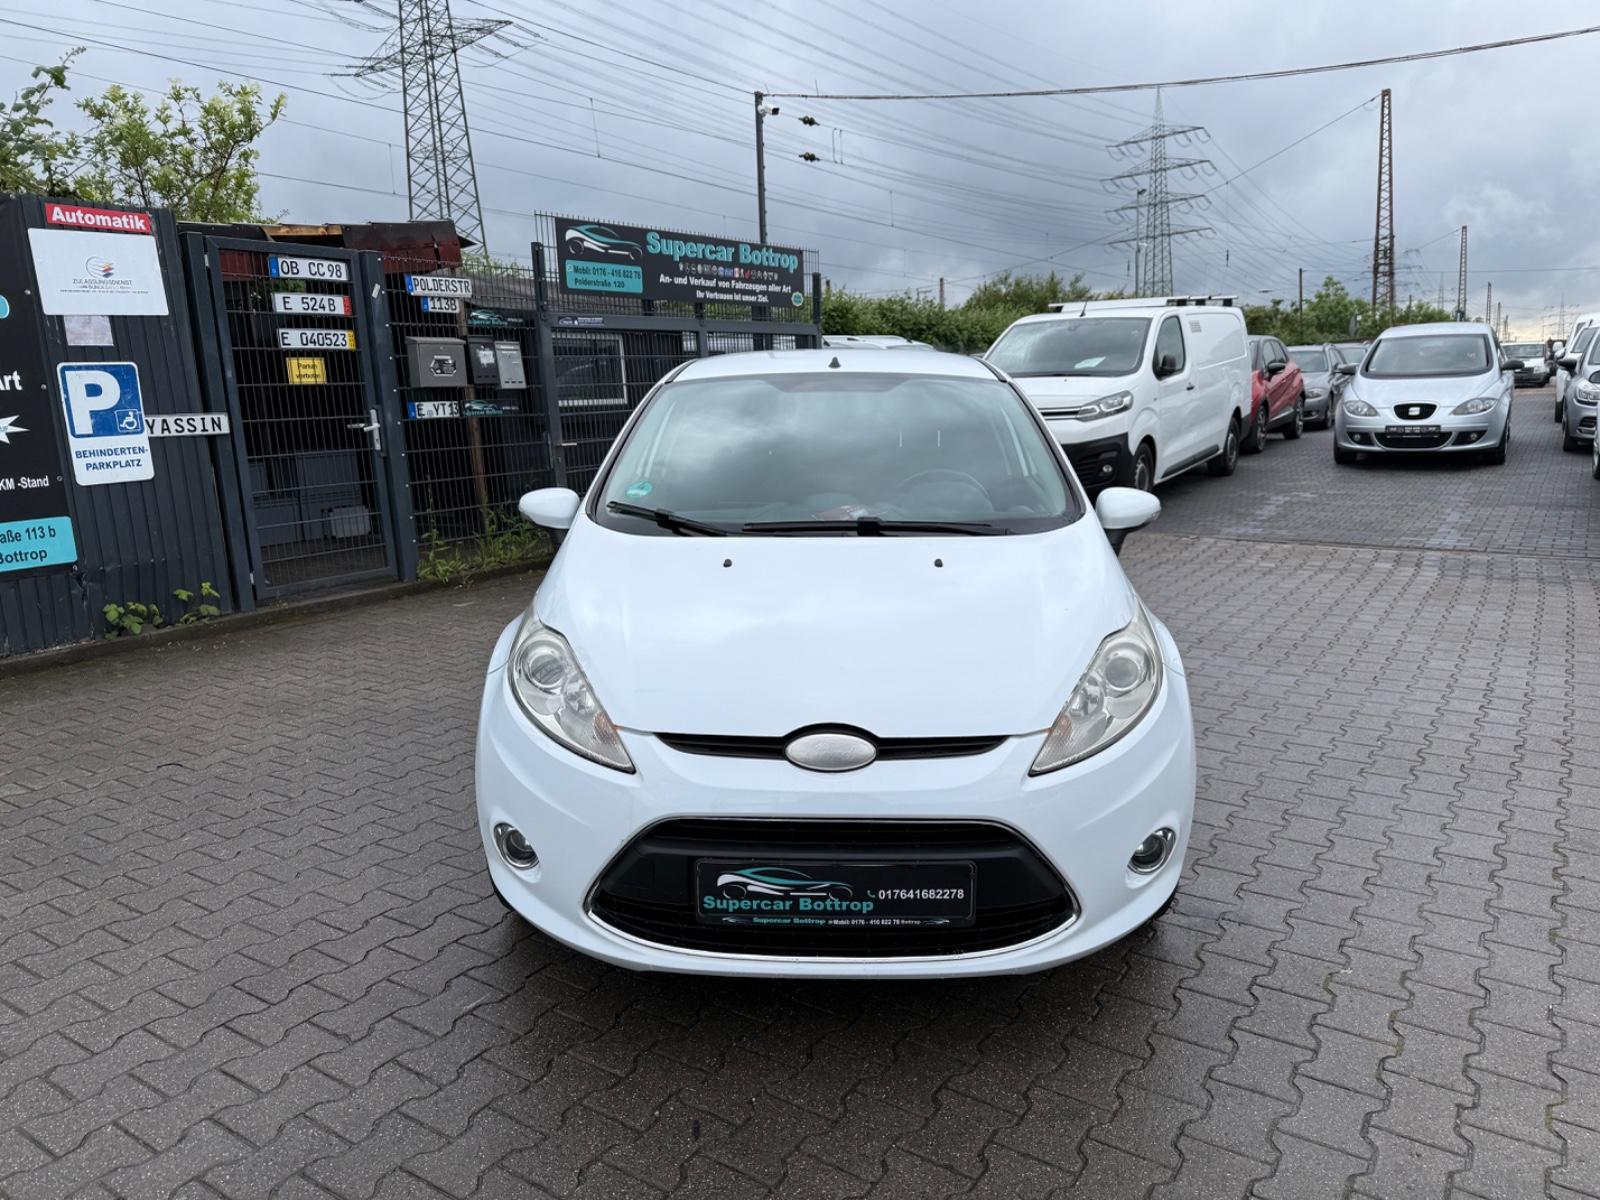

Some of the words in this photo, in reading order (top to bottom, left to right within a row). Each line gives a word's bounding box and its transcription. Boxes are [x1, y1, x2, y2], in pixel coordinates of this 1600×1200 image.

[51, 206, 146, 231] Automatik
[645, 231, 735, 262] Supercar
[739, 243, 799, 273] Bottrop
[280, 260, 300, 275] OB
[412, 277, 471, 293] POLDERSTR
[660, 273, 672, 283] An-
[673, 275, 688, 285] und
[689, 276, 717, 287] Verkauf
[731, 280, 767, 292] Fahrzeugen
[782, 284, 792, 293] Art
[282, 296, 293, 311] E
[280, 331, 291, 346] E
[300, 332, 347, 347] 040523
[64, 370, 121, 435] P
[147, 416, 223, 435] YASSIN
[75, 446, 149, 459] BEHINDERTEN-
[85, 459, 143, 471] PARKPLATZ
[25, 526, 46, 540] 113
[48, 525, 56, 538] b
[703, 896, 793, 912] Supercar
[799, 897, 875, 914] Bottrop
[878, 888, 965, 899] 017641682278
